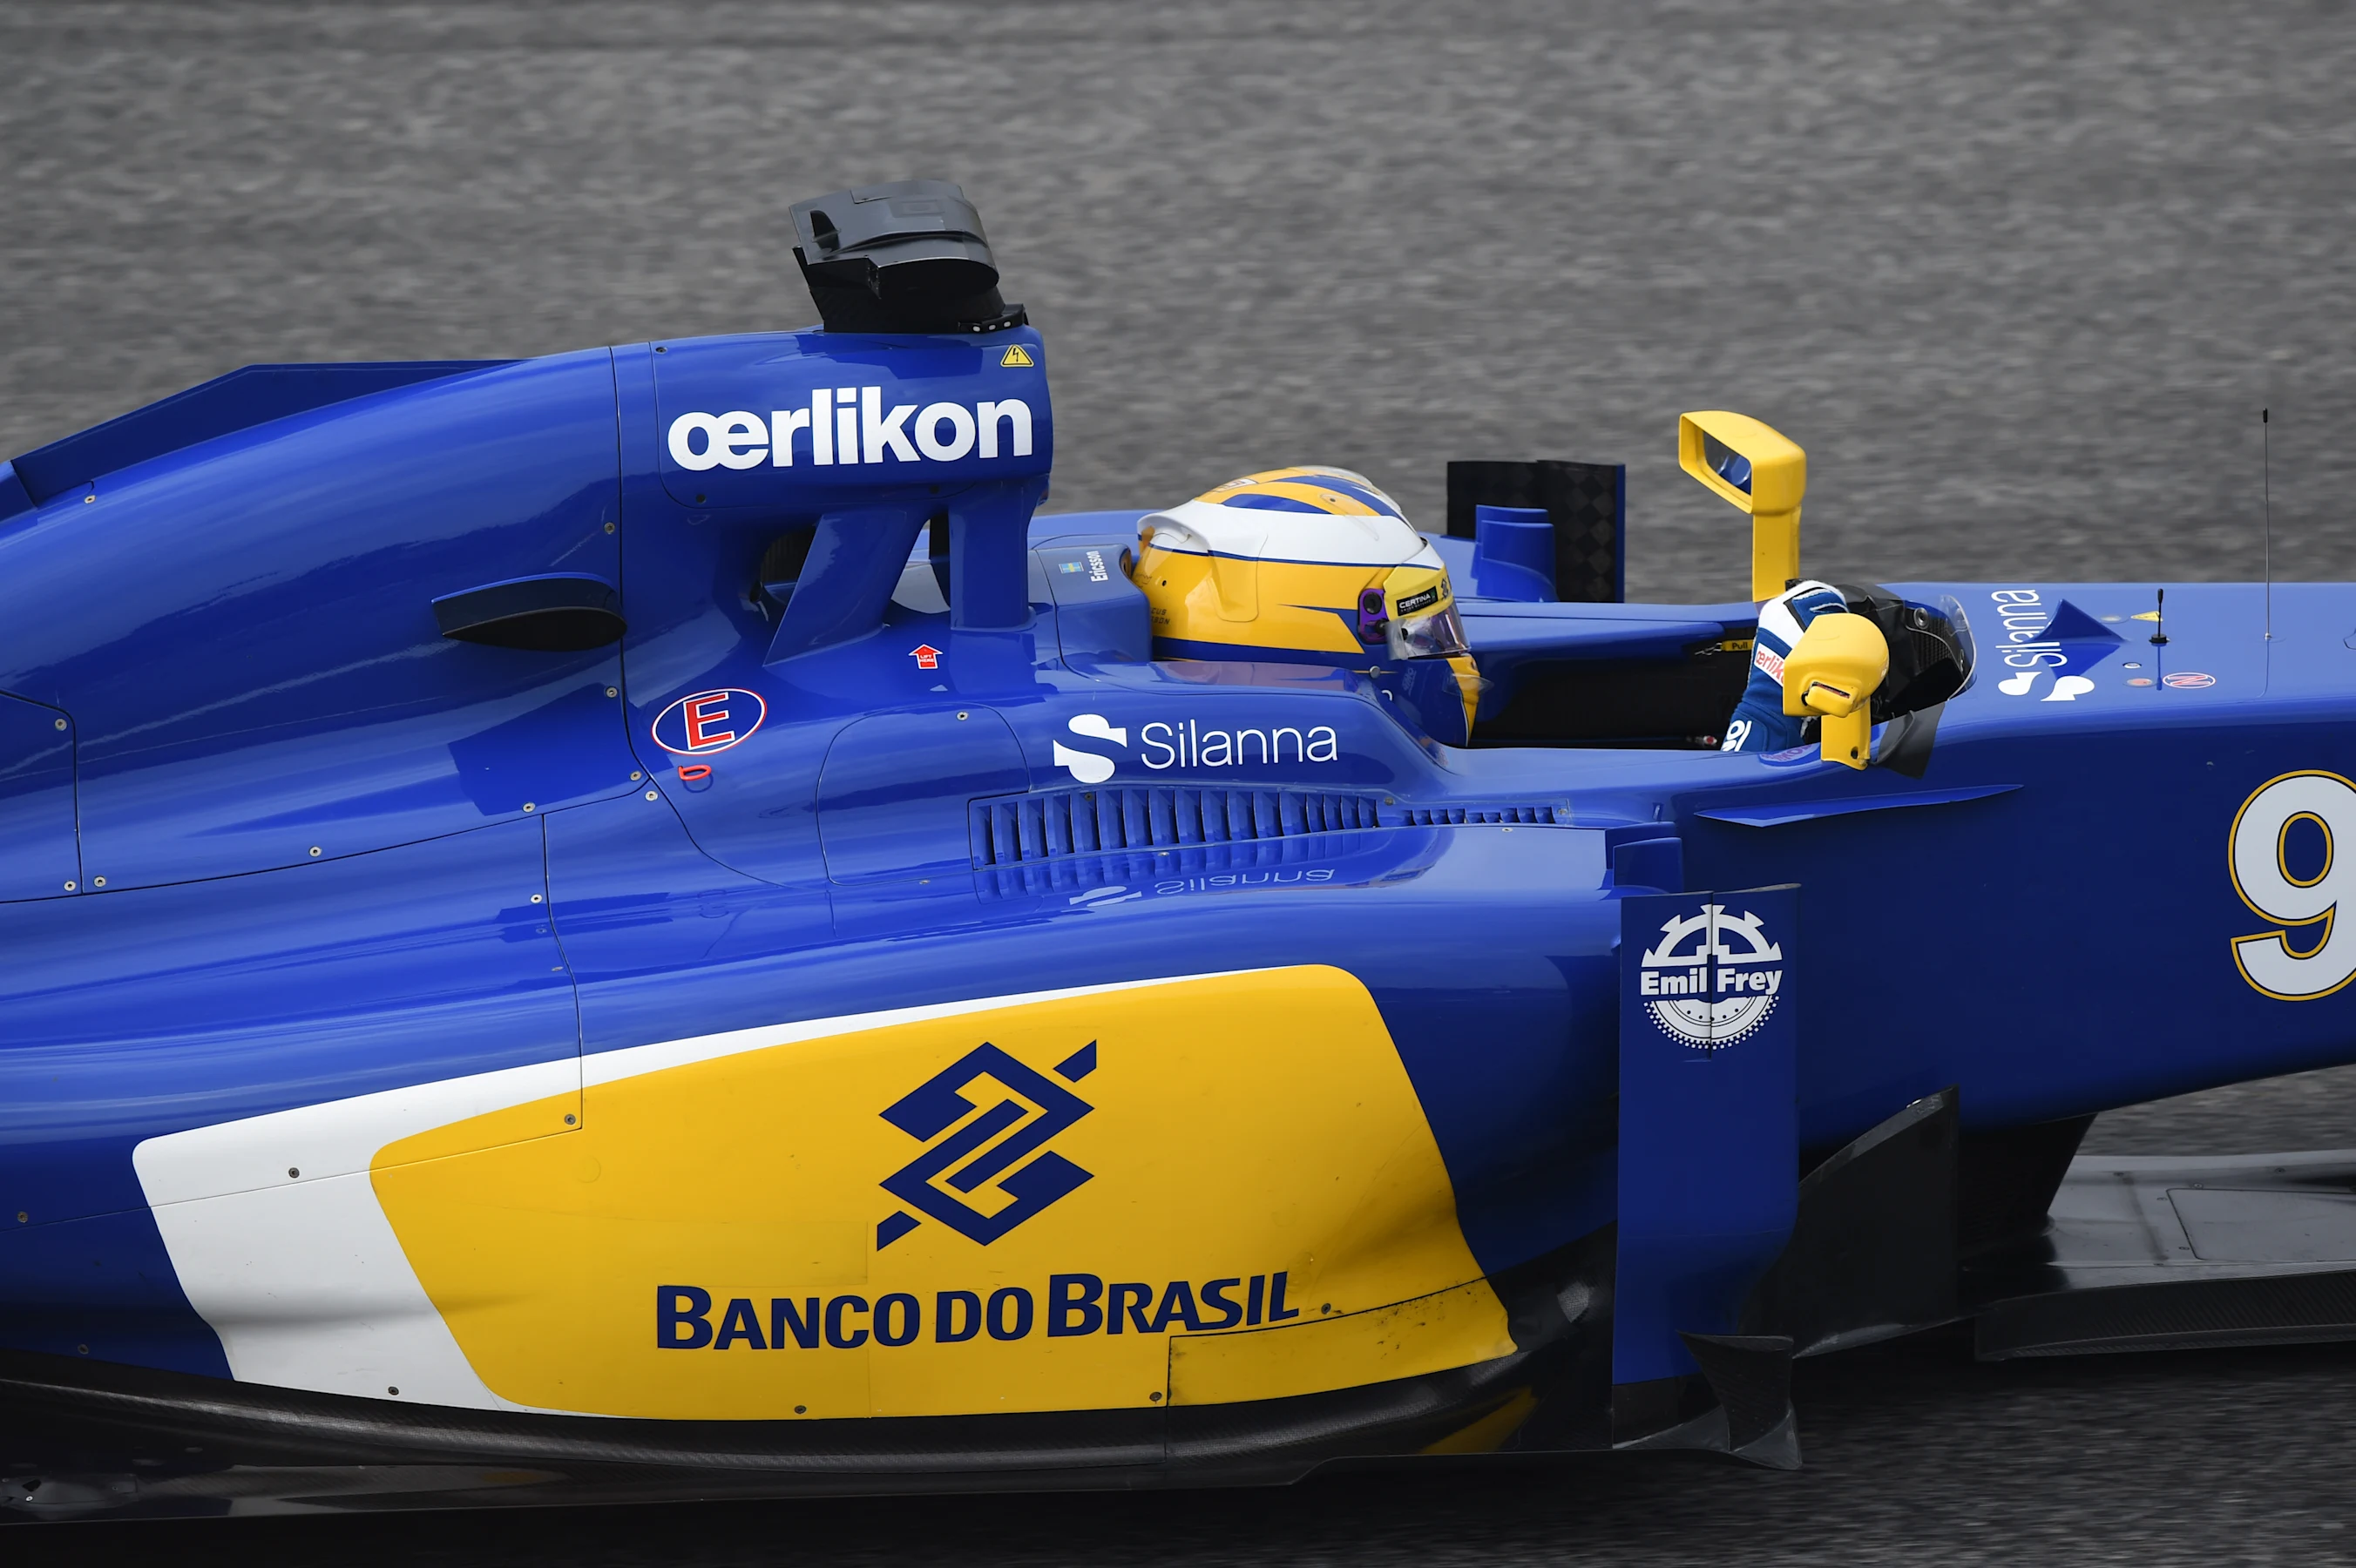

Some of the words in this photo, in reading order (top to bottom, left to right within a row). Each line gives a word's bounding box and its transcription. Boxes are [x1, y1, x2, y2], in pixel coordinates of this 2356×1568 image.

[1086, 551, 1108, 582] Ericsson
[1150, 607, 1167, 616] CUS
[1399, 593, 1431, 609] CERTINA
[684, 692, 736, 750] E
[1141, 719, 1338, 769] Silanna
[2228, 769, 2356, 1001] 9
[1641, 966, 1708, 996] Emil
[1716, 968, 1783, 995] Frey
[658, 1285, 919, 1348] BANCO
[937, 1288, 1032, 1342] DO
[1048, 1273, 1298, 1336] BRASIL
